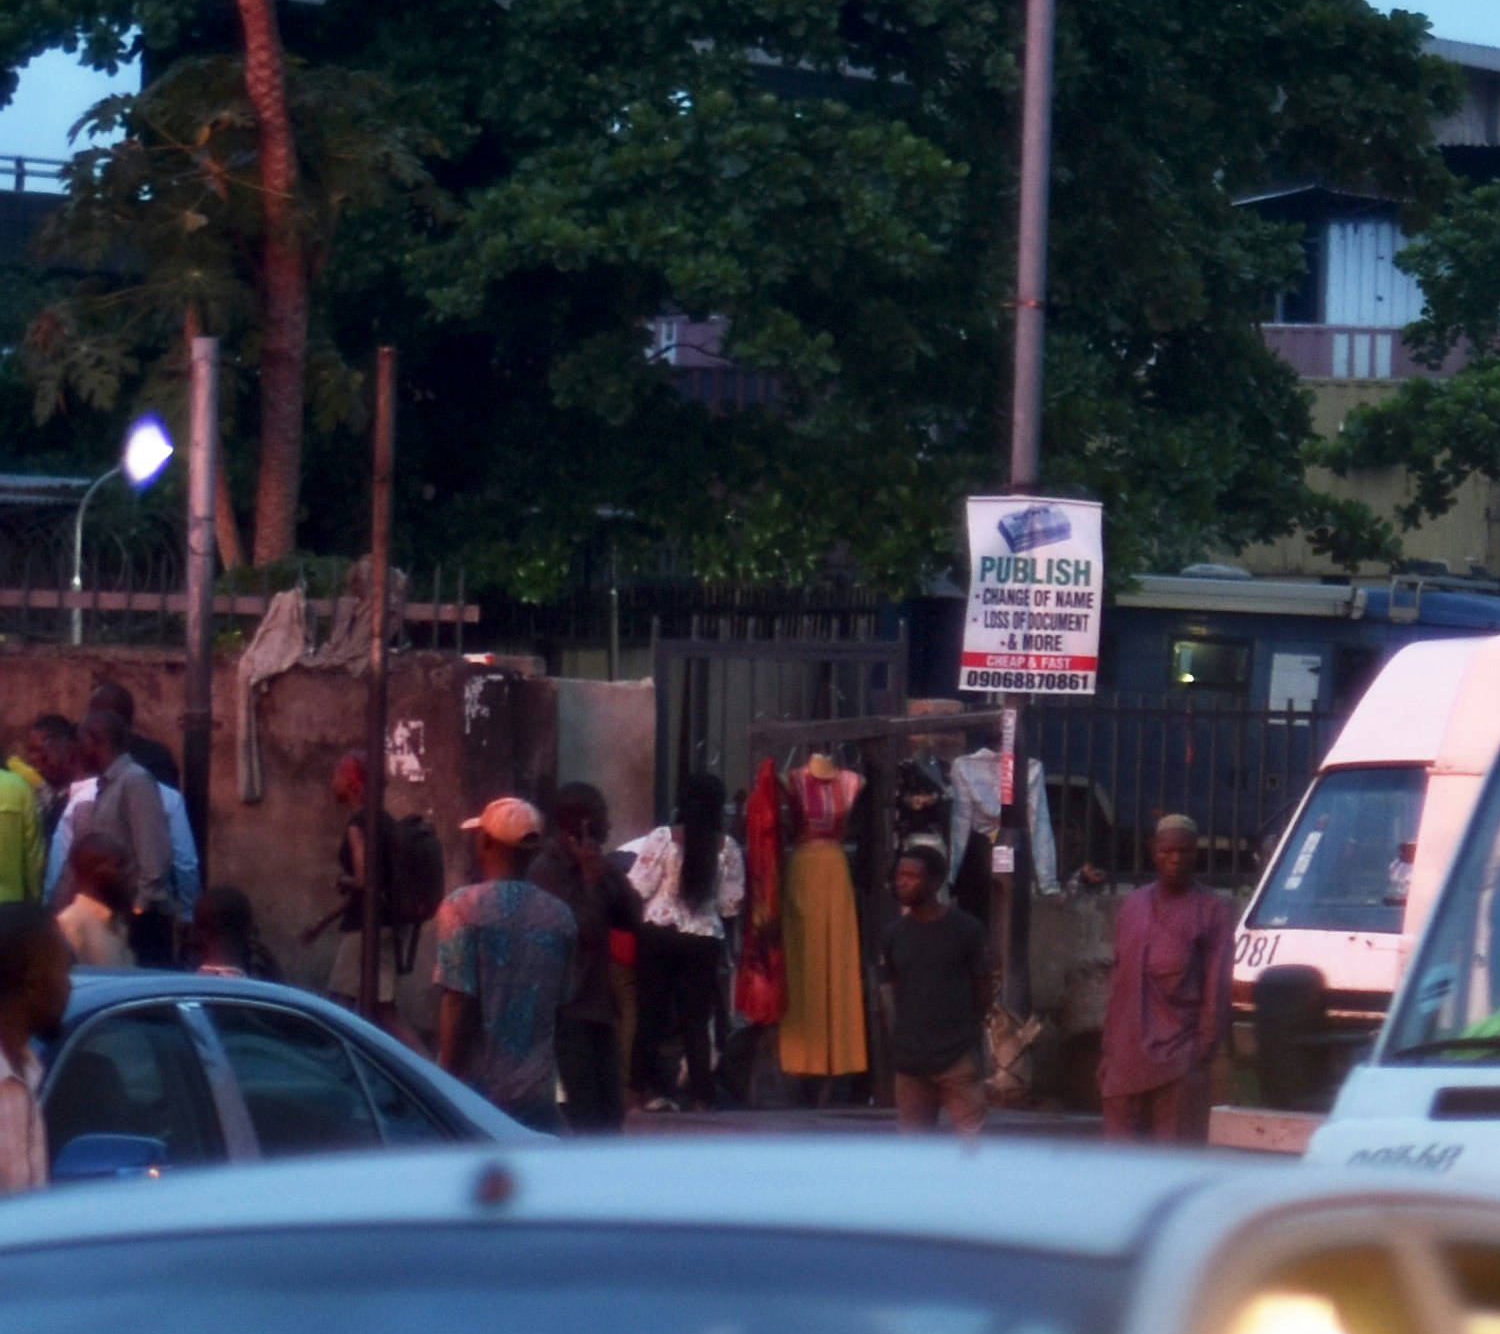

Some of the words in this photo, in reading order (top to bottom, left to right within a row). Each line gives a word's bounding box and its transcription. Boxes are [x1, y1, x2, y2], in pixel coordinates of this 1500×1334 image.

[980, 556, 1091, 586] PUBLISH
[982, 587, 1030, 607] CHANGE
[1034, 589, 1051, 607] OF
[1055, 590, 1094, 609] NAME
[984, 610, 1009, 628] LOSS
[1012, 611, 1026, 629] OF
[1028, 612, 1089, 632] DOCUMENT
[1007, 633, 1017, 650] &
[1022, 634, 1063, 651] MORE
[986, 655, 1026, 667] CHEAP
[1041, 657, 1071, 669] FAST
[967, 670, 1089, 689] 09068870861
